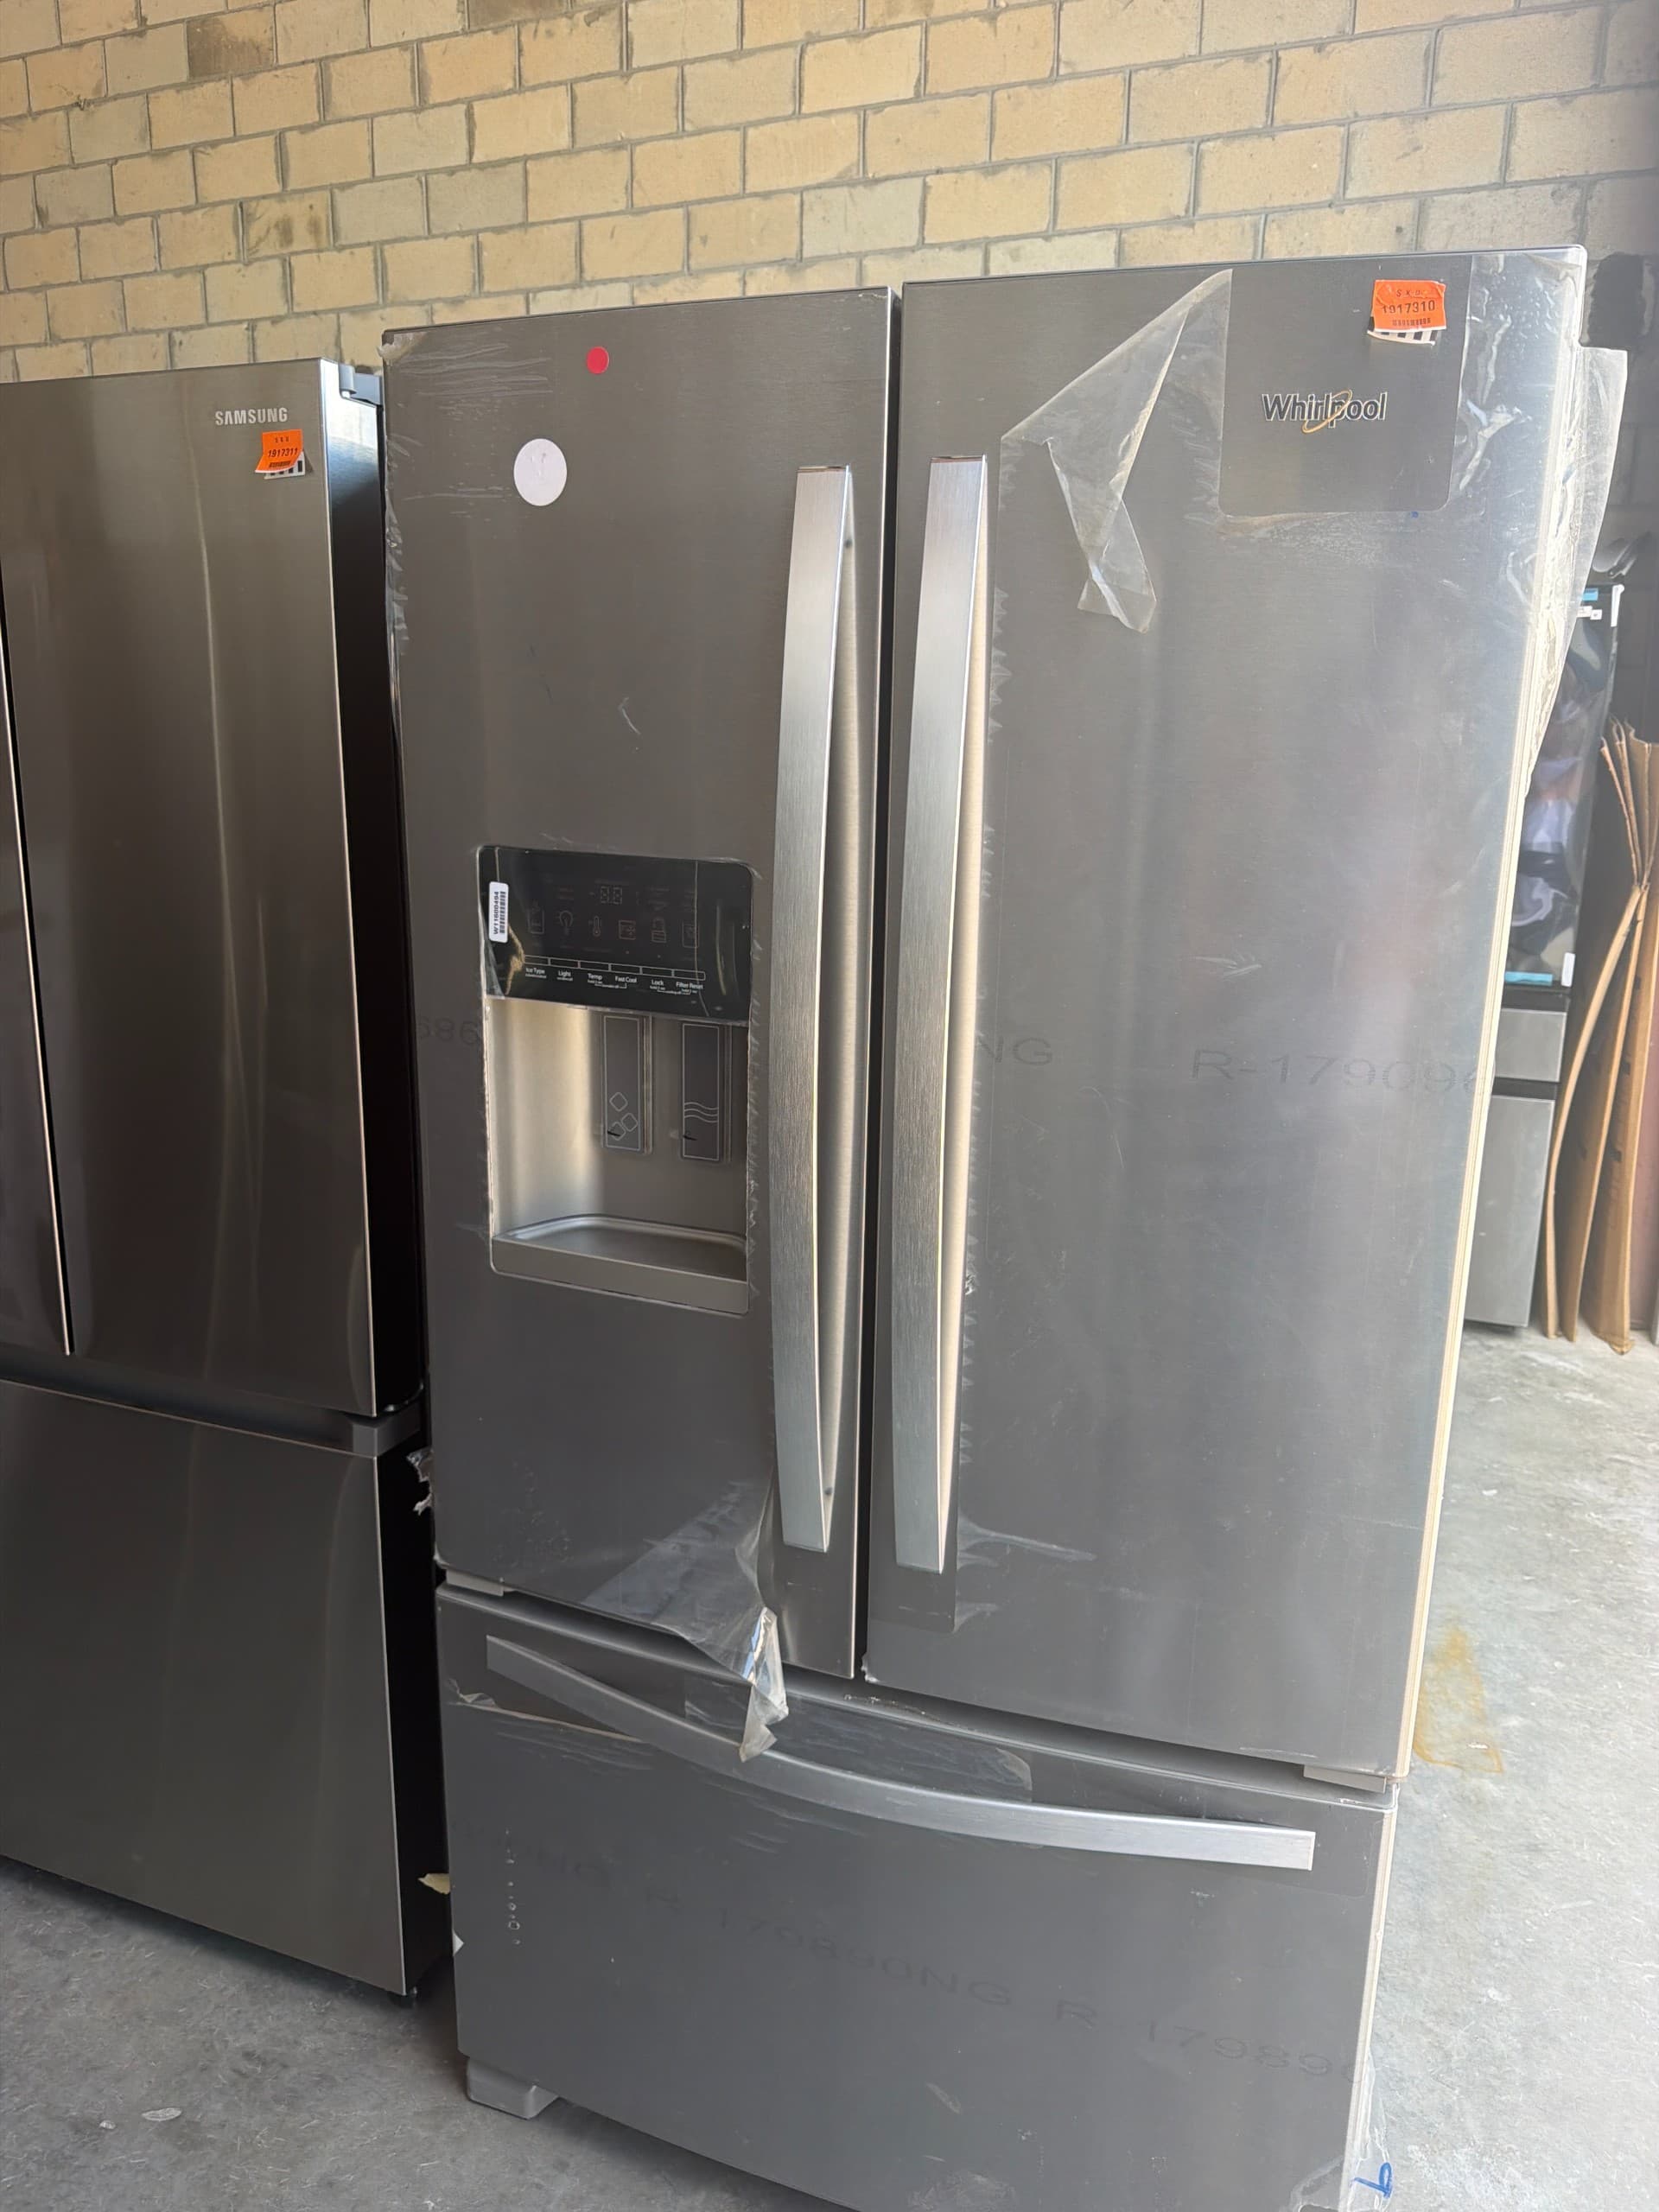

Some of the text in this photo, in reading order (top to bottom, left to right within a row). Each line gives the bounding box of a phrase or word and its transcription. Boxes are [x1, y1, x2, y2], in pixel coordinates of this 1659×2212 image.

[1382, 299, 1435, 315] 1917310
[215, 407, 289, 425] SAMSUNG
[1262, 391, 1388, 429] Whirlpool
[268, 448, 298, 458] 1917311
